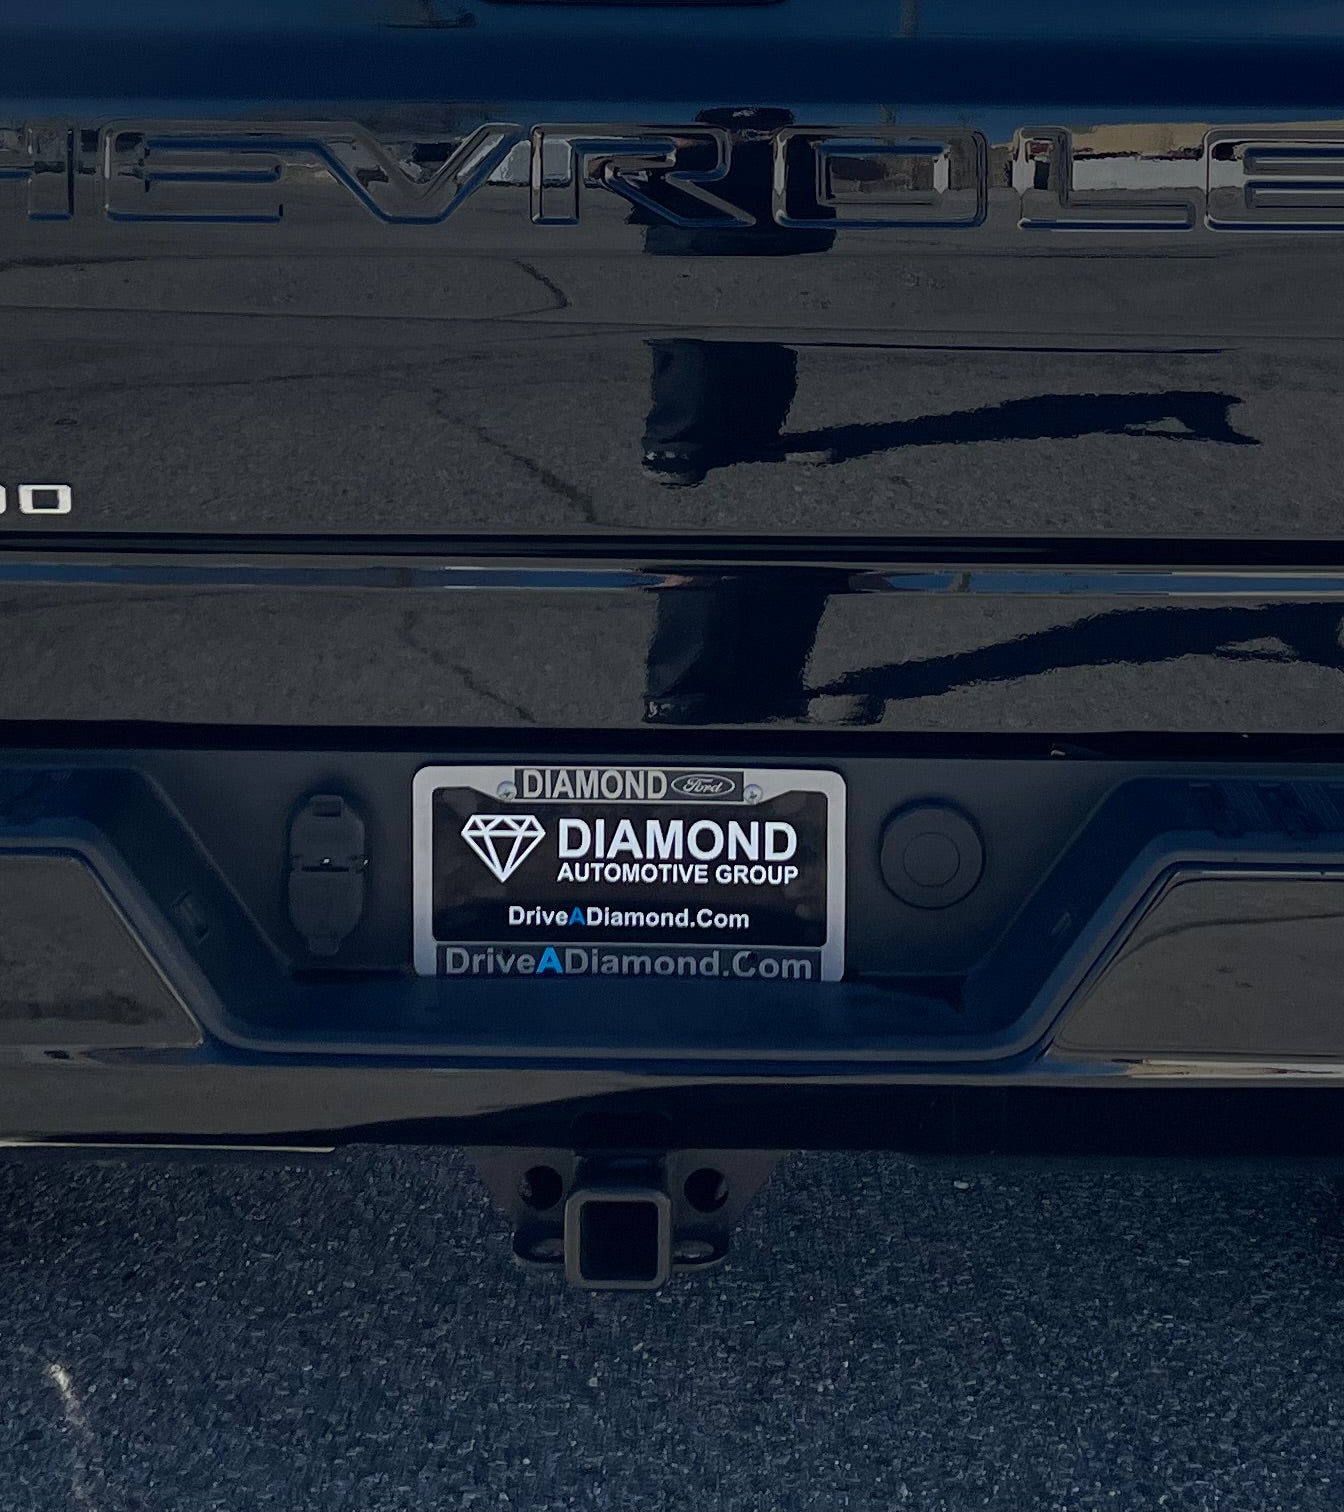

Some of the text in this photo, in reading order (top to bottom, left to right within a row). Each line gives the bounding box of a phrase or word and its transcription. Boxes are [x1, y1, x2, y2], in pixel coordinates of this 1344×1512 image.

[522, 768, 668, 801] DIAMOND
[557, 817, 798, 862] DIAMOND
[556, 862, 799, 885] AUTOMOTIVE GROUP
[508, 905, 750, 929] DriveADiamond.Com
[446, 946, 813, 980] DriveADiamond.Com
